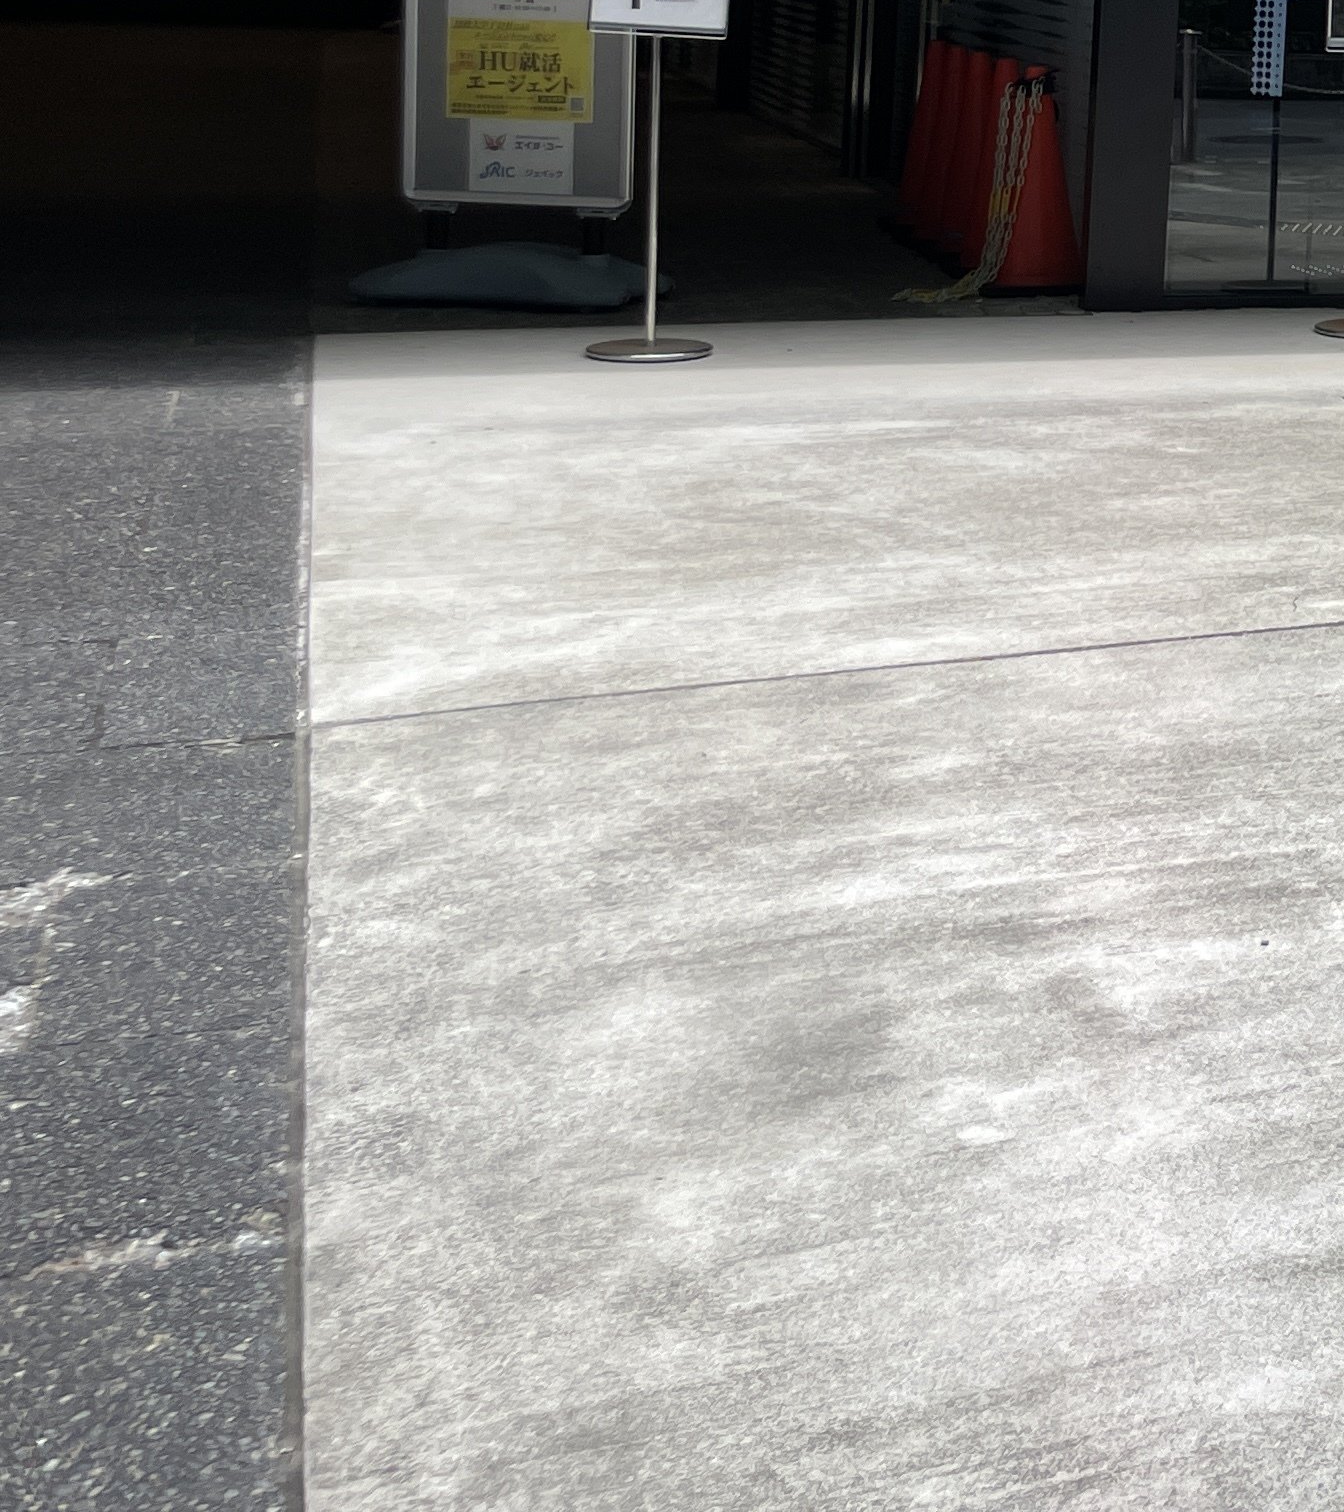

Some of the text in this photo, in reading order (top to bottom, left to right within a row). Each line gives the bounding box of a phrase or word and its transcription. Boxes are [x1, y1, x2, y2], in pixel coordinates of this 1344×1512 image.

[479, 51, 562, 73] HU就活
[466, 74, 574, 94] エージェント
